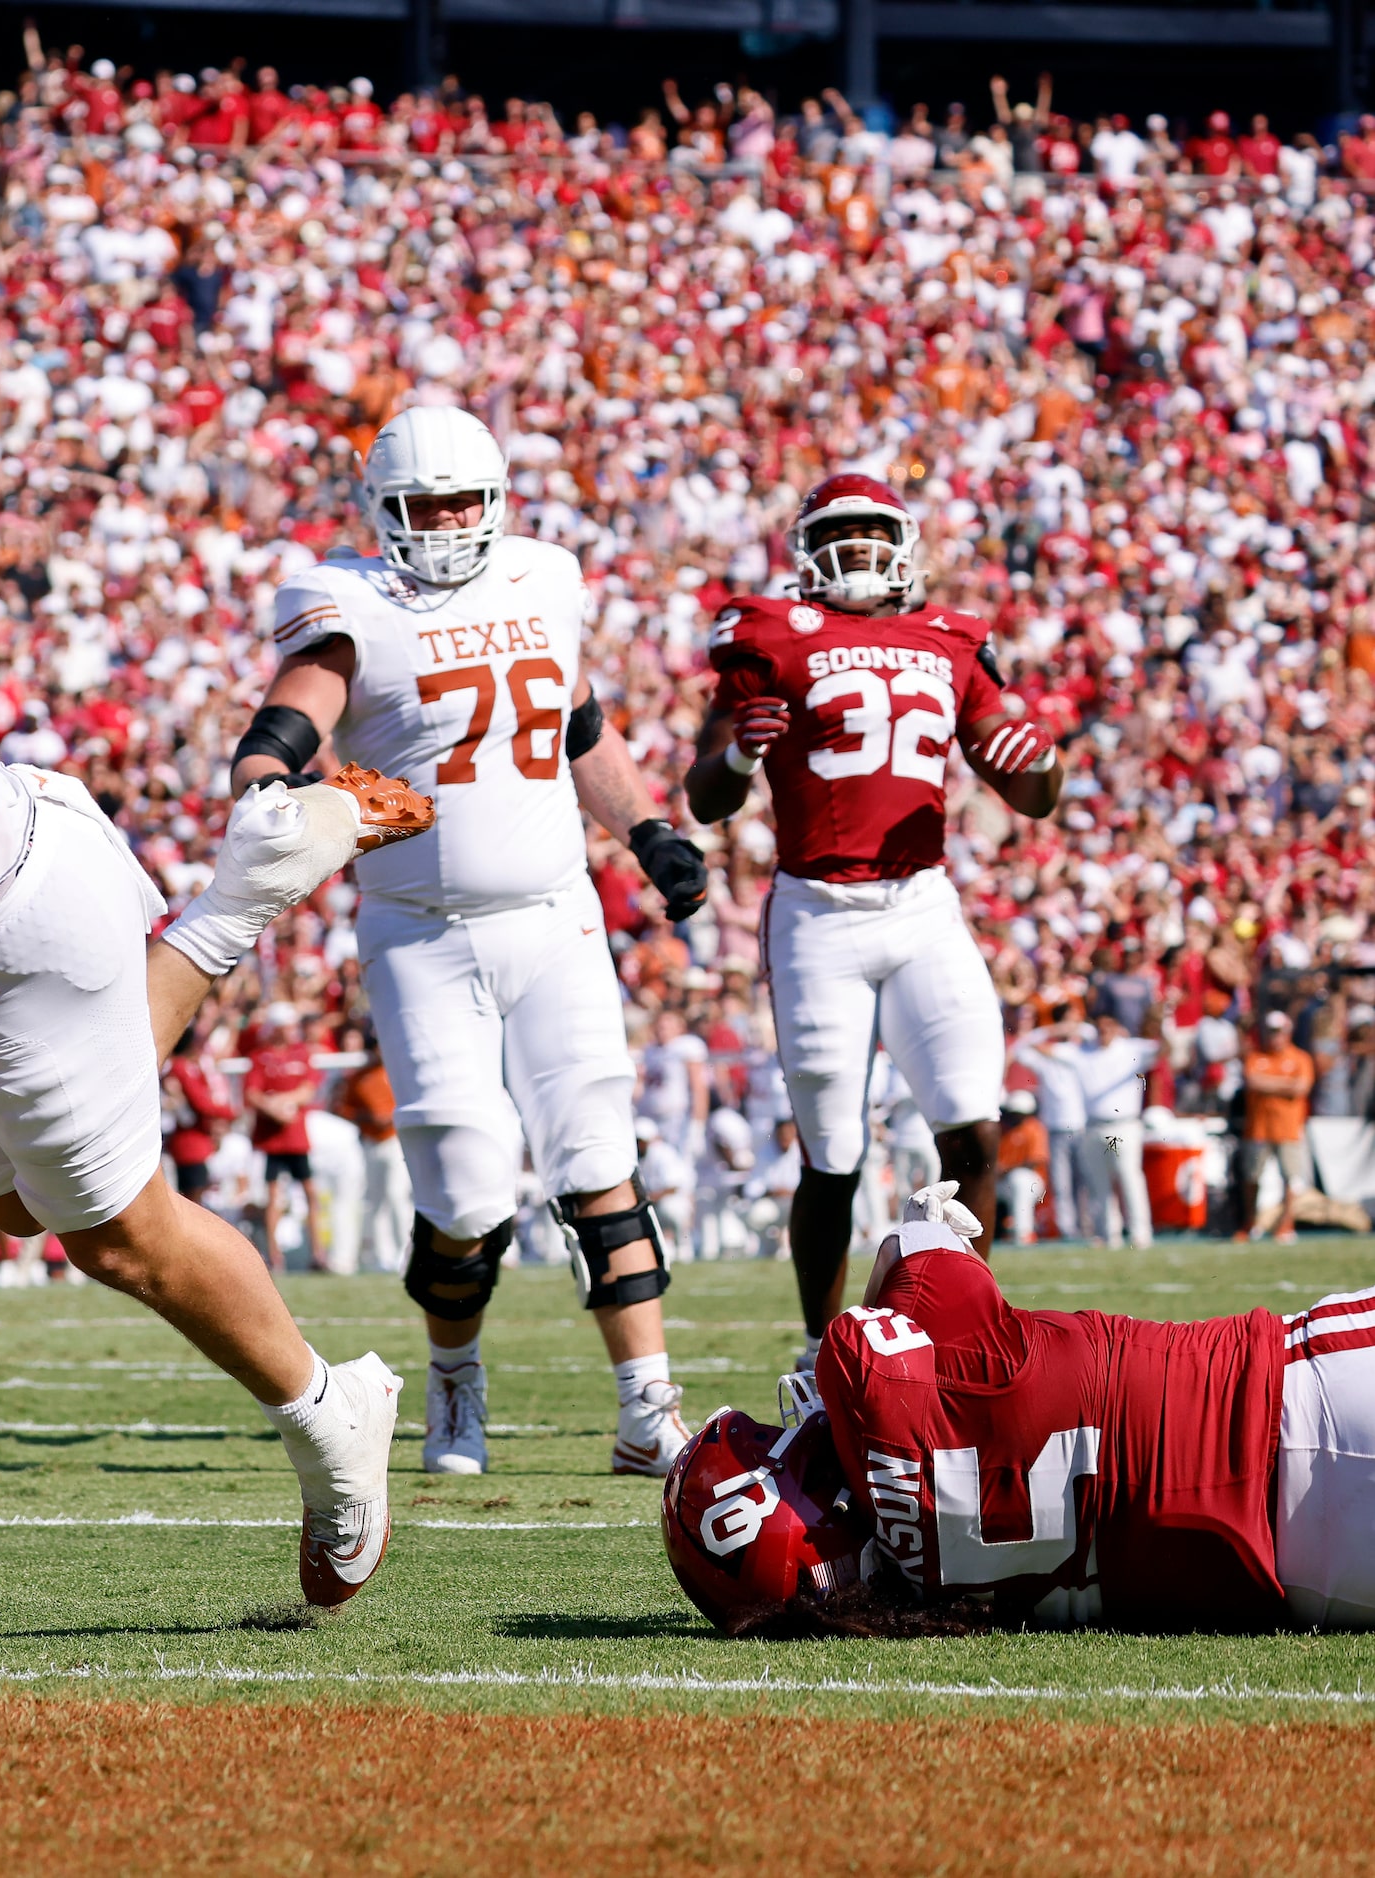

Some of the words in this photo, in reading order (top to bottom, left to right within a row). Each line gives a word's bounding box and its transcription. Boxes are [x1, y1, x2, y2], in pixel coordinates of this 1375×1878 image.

[418, 616, 549, 664] TEXAS
[807, 646, 953, 684] SOONERS
[416, 657, 564, 785] 76
[805, 668, 956, 789] 32
[864, 1448, 924, 1598] KSON
[933, 1425, 1102, 1615] 5
